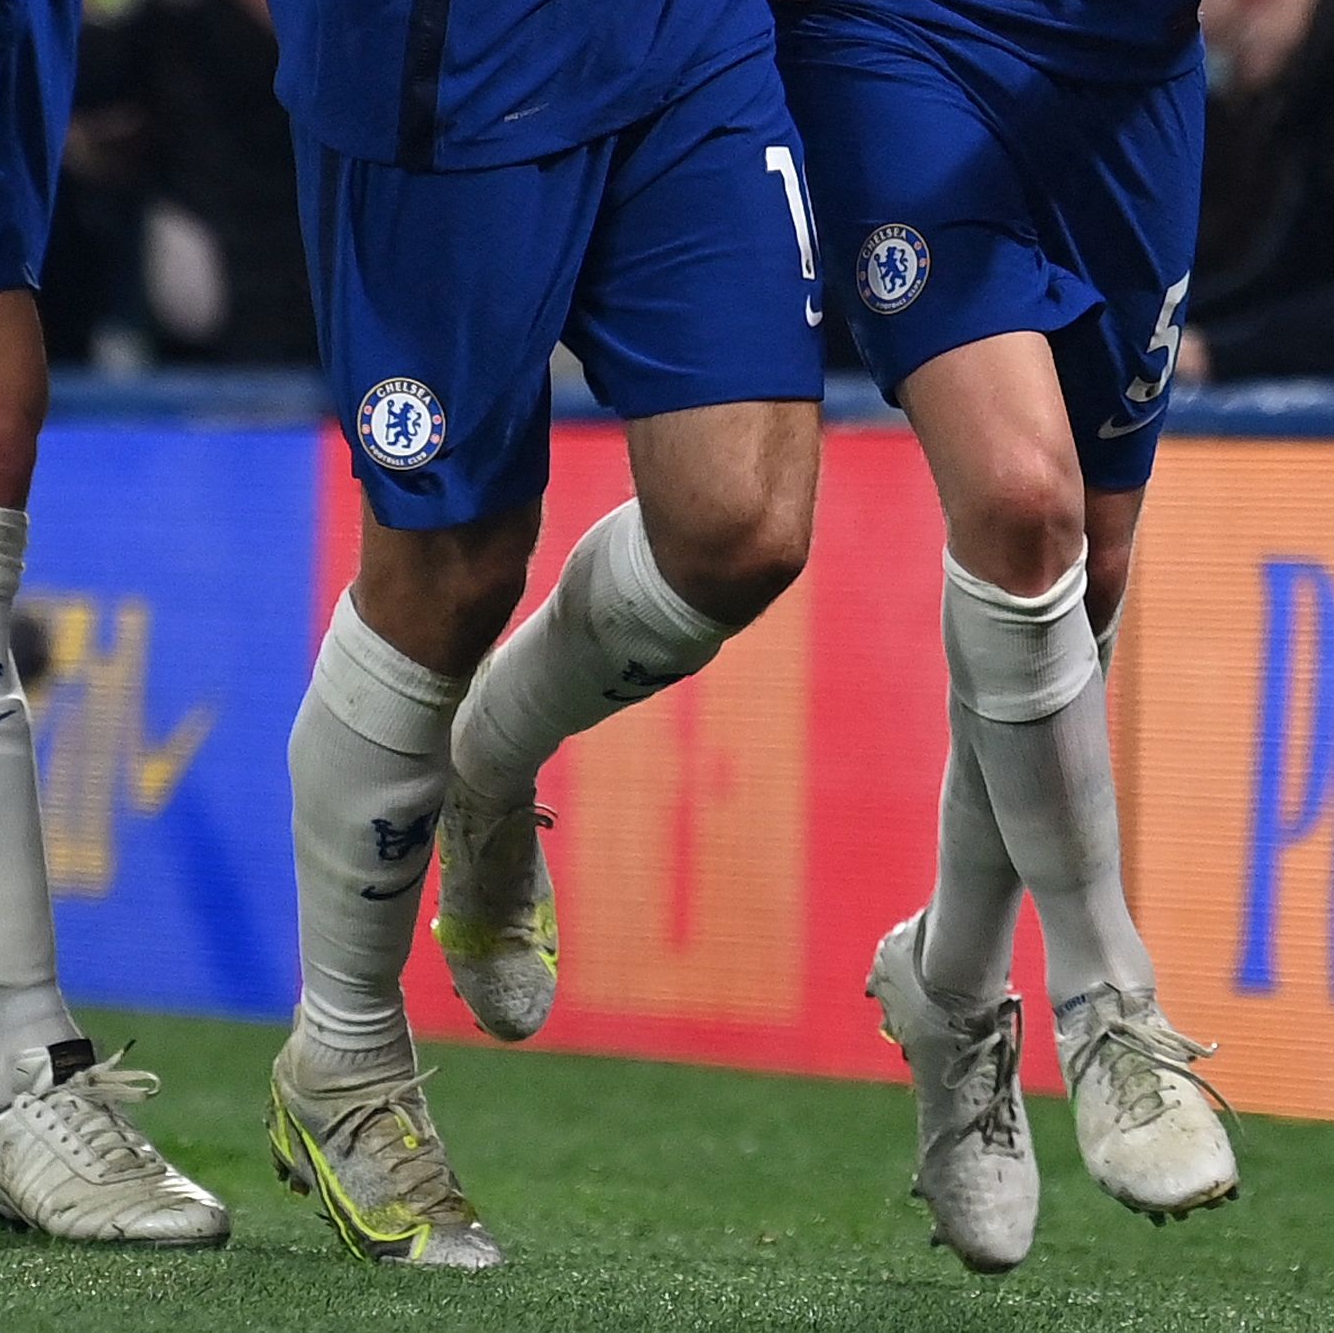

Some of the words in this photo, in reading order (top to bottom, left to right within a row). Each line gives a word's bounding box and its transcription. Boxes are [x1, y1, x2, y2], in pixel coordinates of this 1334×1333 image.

[862, 228, 907, 259] CHELSEA
[1125, 269, 1190, 403] 5
[376, 381, 432, 405] CHELSEA
